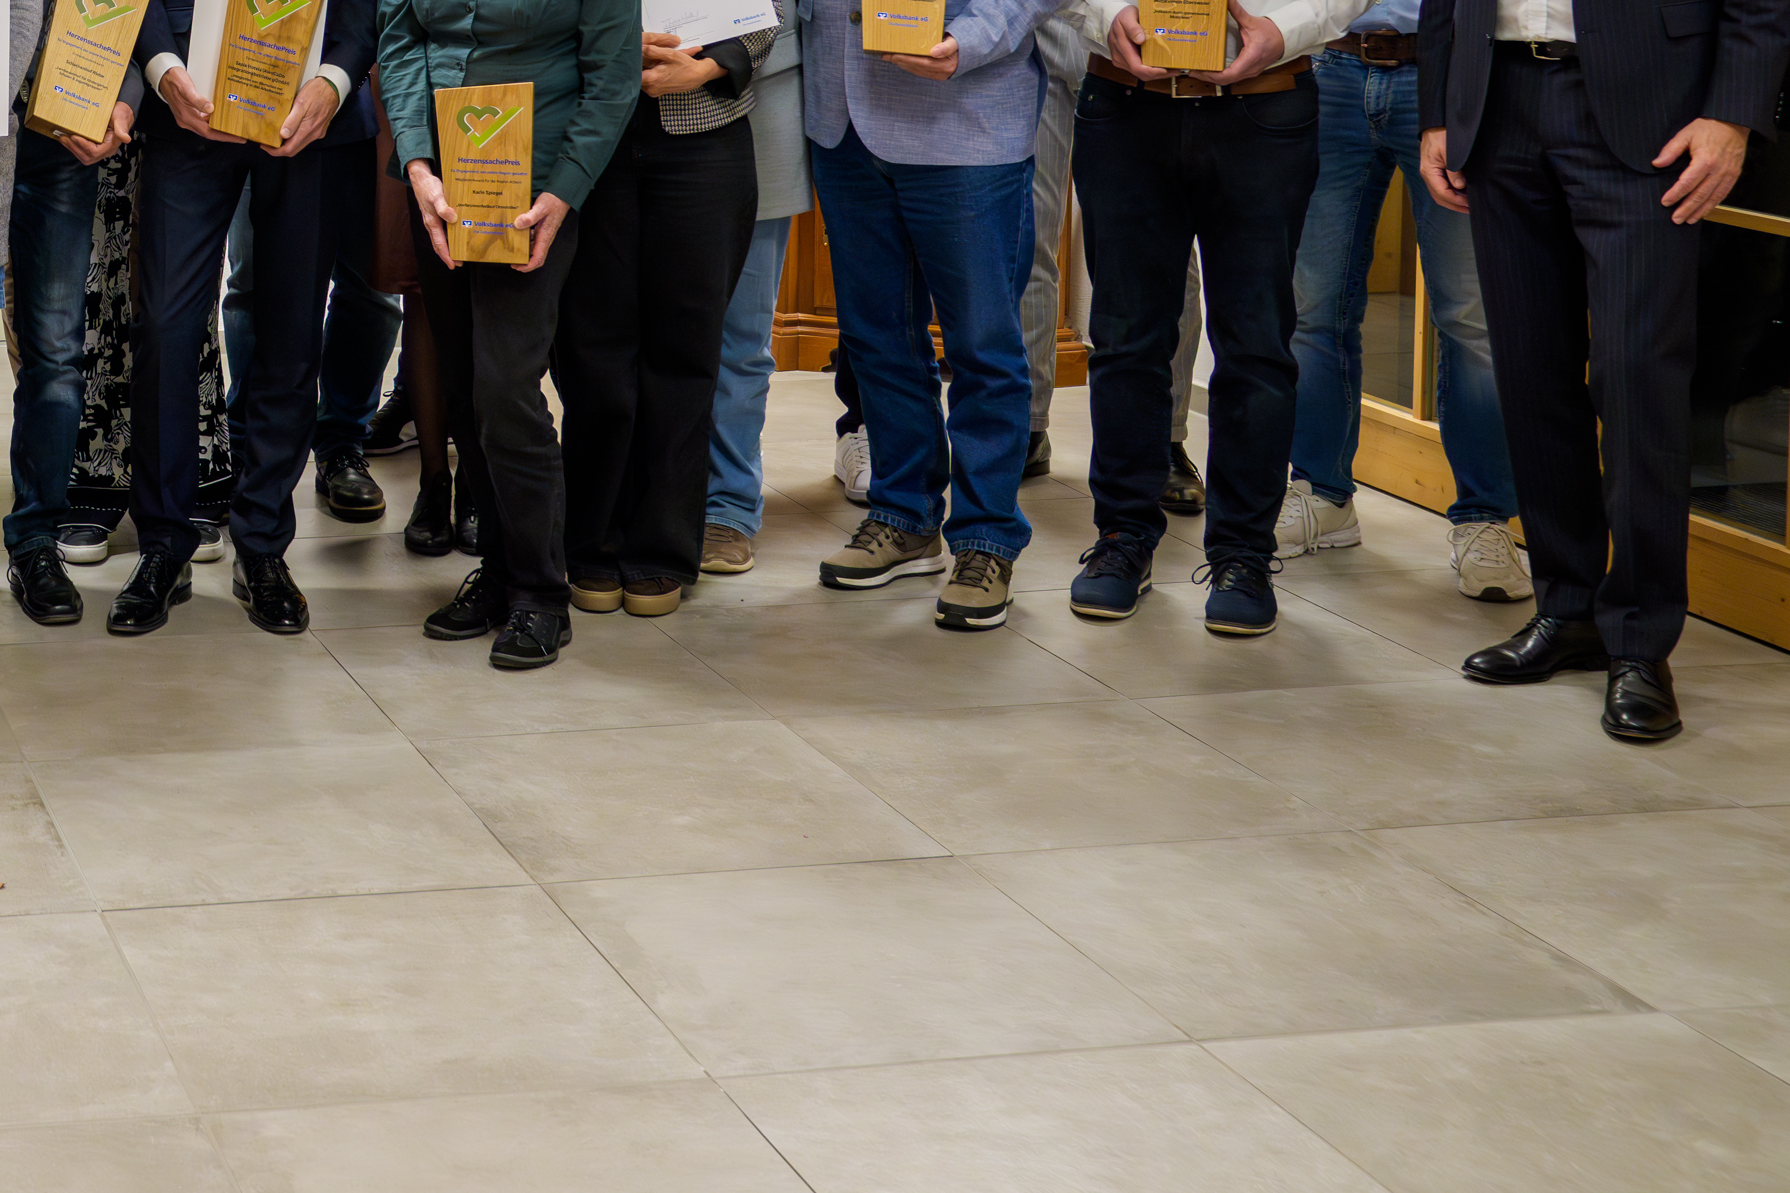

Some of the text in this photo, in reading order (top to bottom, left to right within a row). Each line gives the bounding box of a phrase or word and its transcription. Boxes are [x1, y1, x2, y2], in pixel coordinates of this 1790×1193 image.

[66, 30, 121, 57] HerzenssachePreis
[238, 33, 296, 55] HerzenssachePreis
[64, 90, 91, 104] Volksbank
[239, 97, 267, 109] Volksbank
[457, 157, 521, 166] HerzenssachePreis
